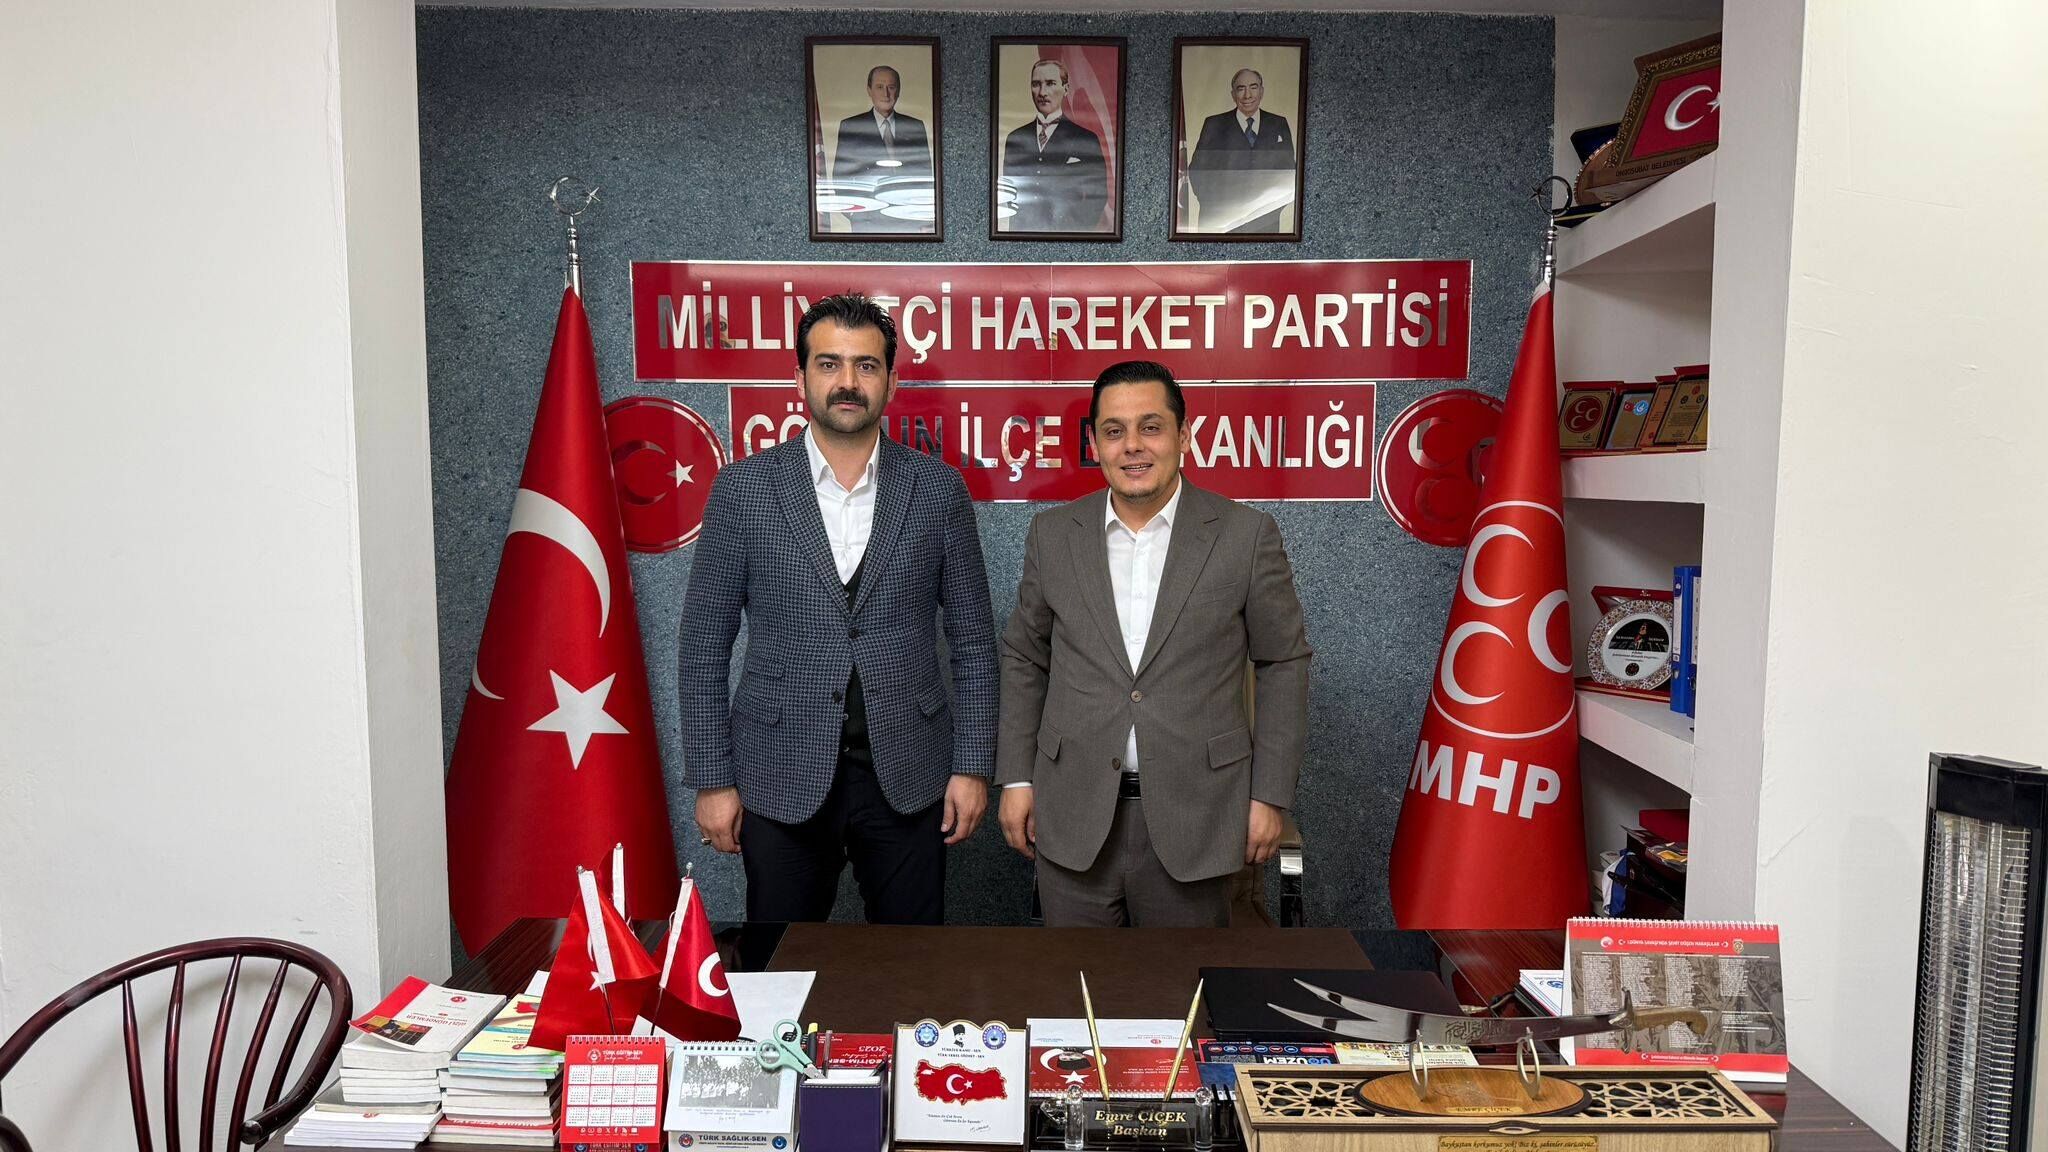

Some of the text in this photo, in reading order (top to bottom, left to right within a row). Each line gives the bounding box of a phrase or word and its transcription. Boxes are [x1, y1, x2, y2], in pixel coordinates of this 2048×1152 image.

[658, 278, 1447, 364] MİLLİTÇİ HAREKET PARTİSİ
[960, 402, 1061, 481] İLÇE
[1080, 401, 1363, 468] BKANLIĞI
[1408, 740, 1561, 819] MHP
[1095, 1110, 1187, 1124] Emre ÇİÇEK
[1113, 1125, 1168, 1138] Başkan
